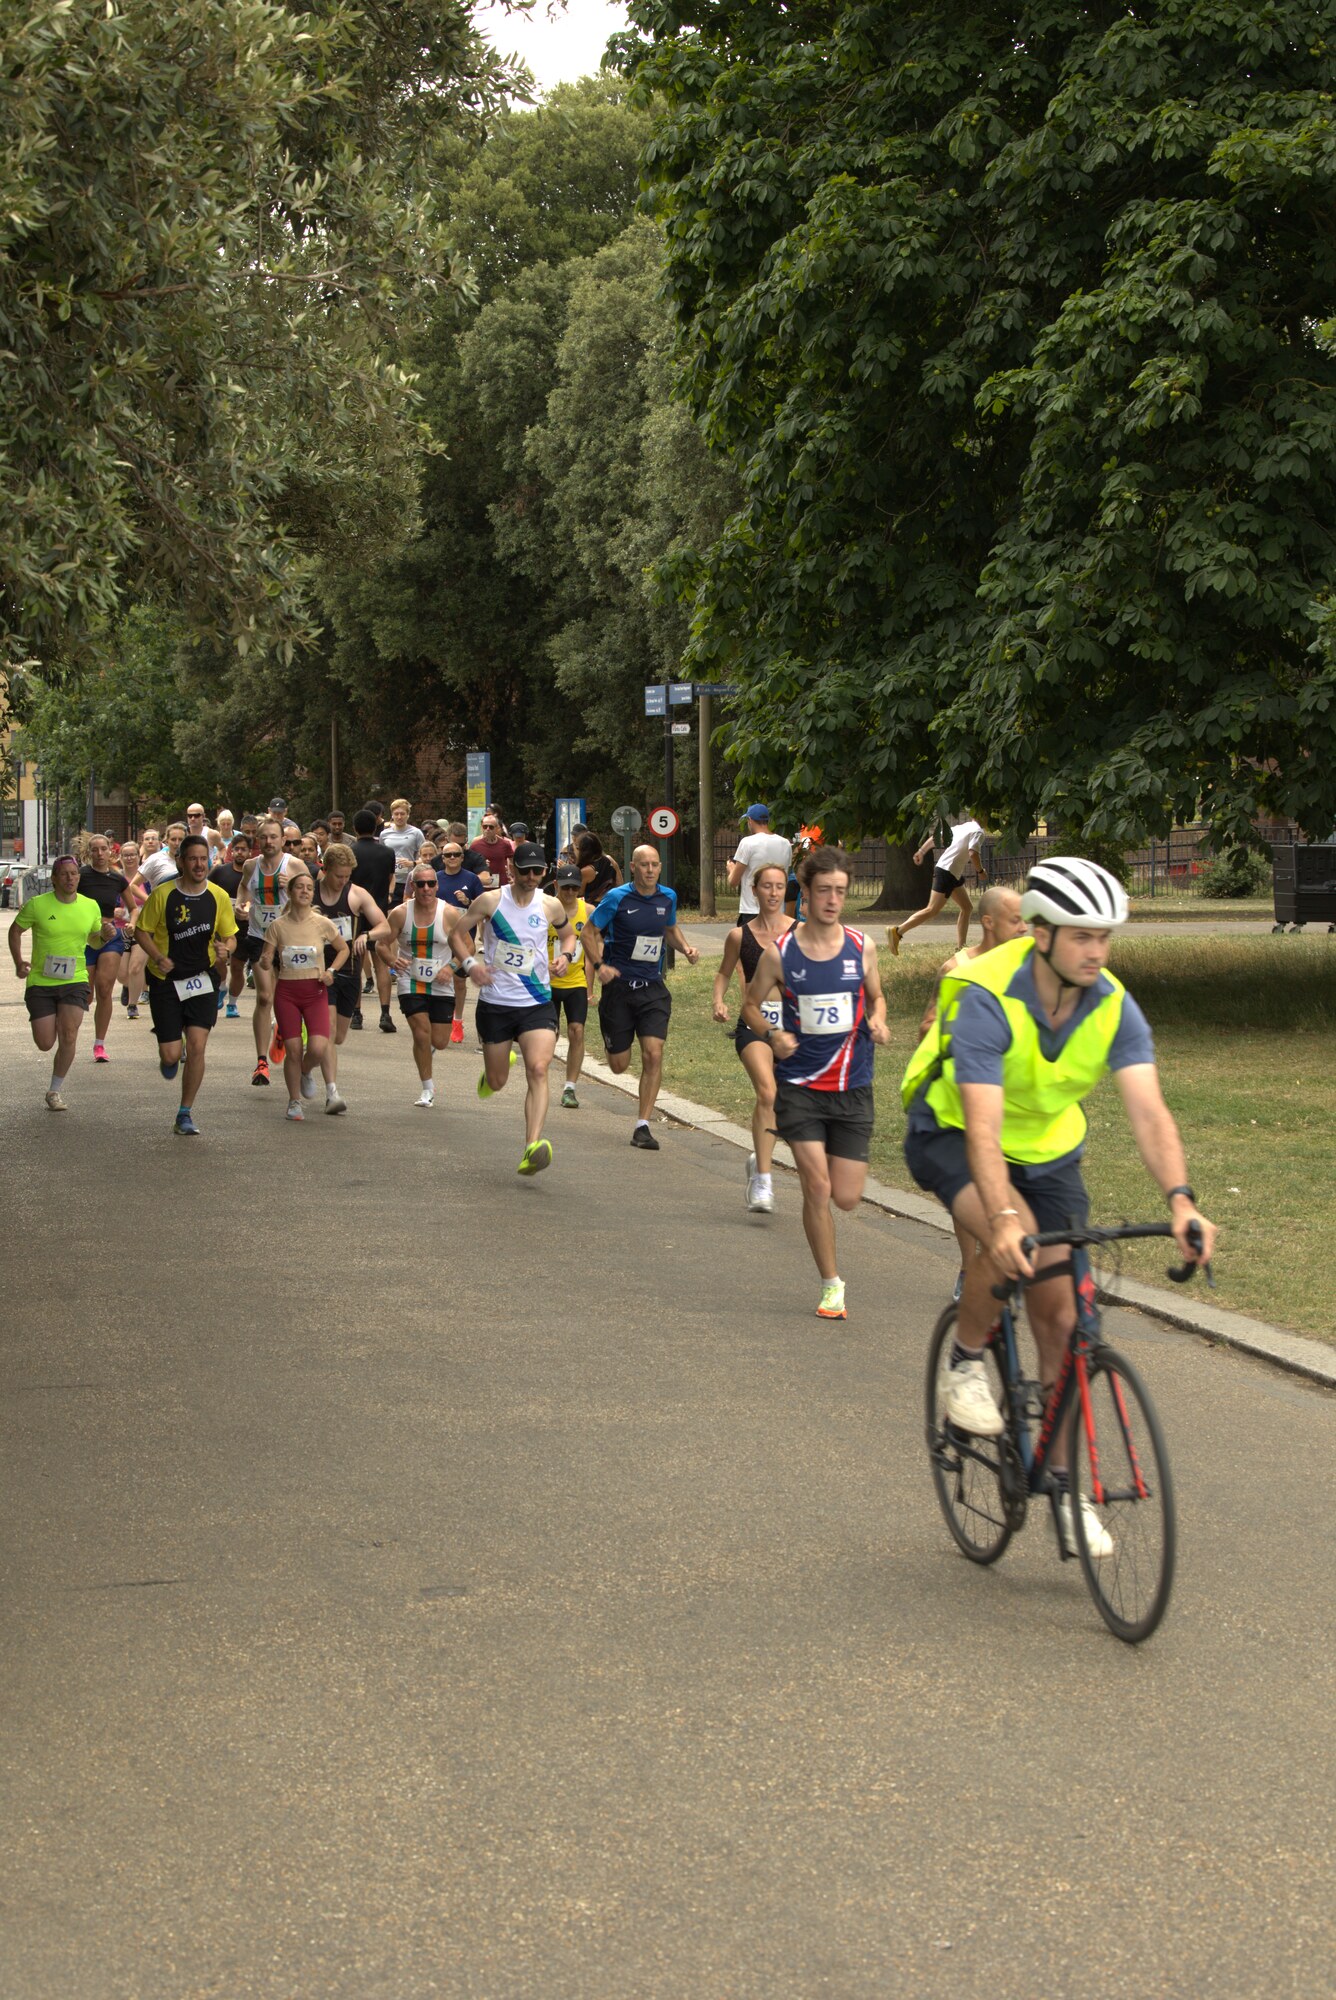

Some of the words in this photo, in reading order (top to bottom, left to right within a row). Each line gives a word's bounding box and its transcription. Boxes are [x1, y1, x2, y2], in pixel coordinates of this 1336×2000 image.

[659, 816, 668, 828] 5
[262, 912, 276, 923] 75
[174, 922, 211, 941] Run&Frite
[643, 944, 658, 956] 74
[291, 953, 307, 964] 49
[504, 952, 524, 967] 23
[53, 962, 67, 974] 71
[418, 965, 433, 977] 16
[185, 978, 202, 991] 40
[813, 1006, 839, 1025] 78
